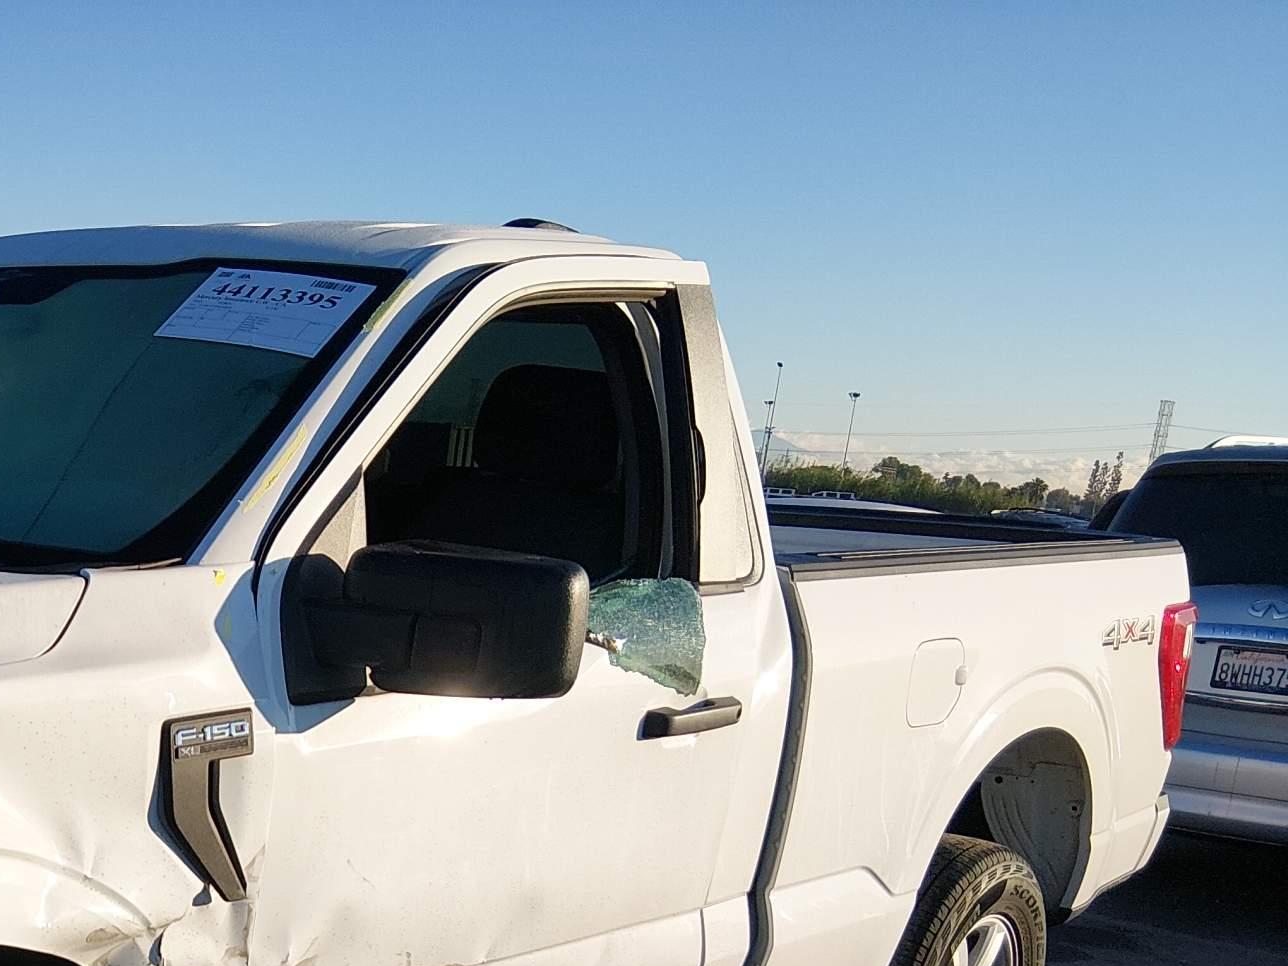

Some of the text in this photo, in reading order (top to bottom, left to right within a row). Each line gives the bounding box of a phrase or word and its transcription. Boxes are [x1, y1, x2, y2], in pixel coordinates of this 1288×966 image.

[212, 282, 343, 309] 44113395
[1218, 662, 1288, 689] 8WHH37
[175, 720, 249, 747] F-150
